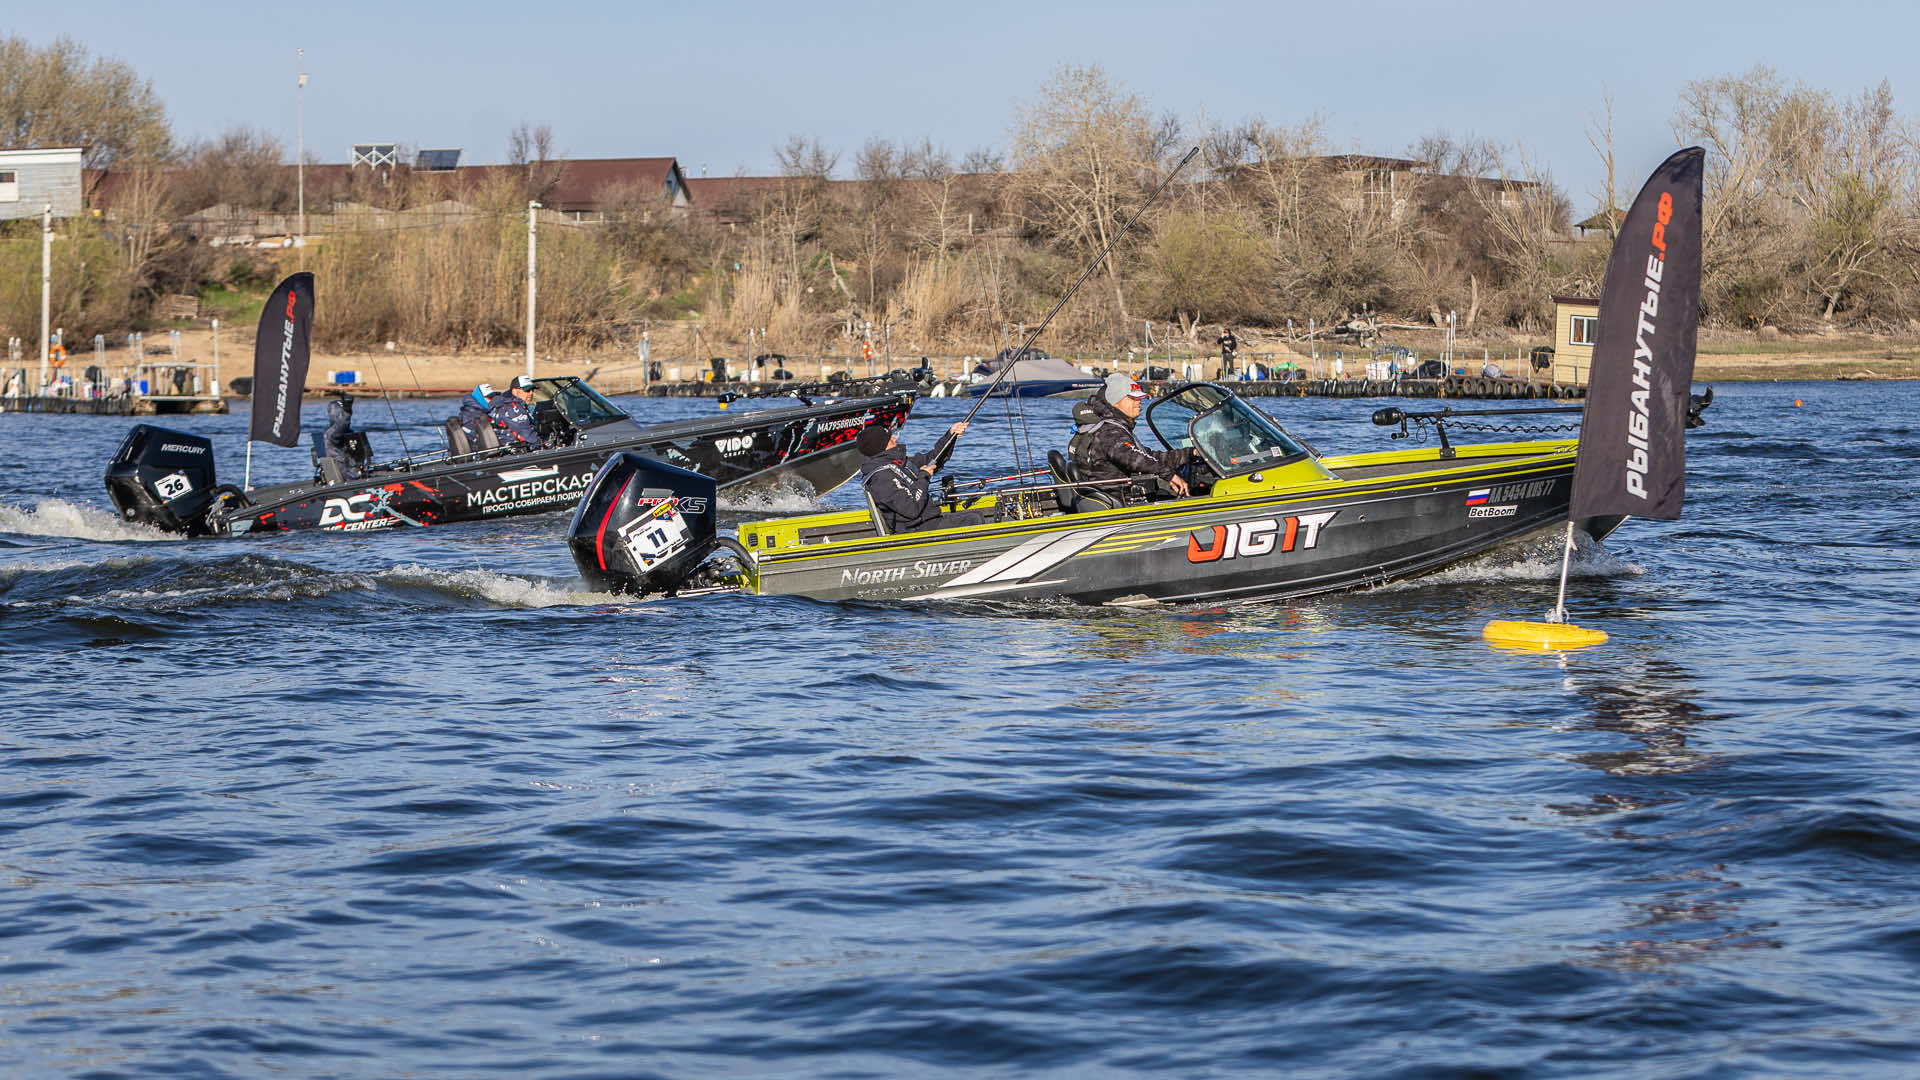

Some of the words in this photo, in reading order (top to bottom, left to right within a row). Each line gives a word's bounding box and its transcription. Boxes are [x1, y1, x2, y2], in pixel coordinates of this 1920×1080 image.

[1626, 191, 1672, 499] РЫБАНУТЫЕ.РФ
[272, 290, 296, 438] РЫБАНУТЫЕ.РФ
[161, 443, 206, 455] MERCURY
[164, 478, 184, 496] 26
[466, 472, 594, 507] МАСТЕРСКАЯ
[482, 502, 514, 514] ПРОСТО
[515, 495, 557, 508] СОБИРАЕМ
[556, 490, 585, 502] ЛОДКИ
[1469, 507, 1516, 517] BetBoom
[646, 528, 668, 548] 11
[1187, 511, 1338, 563] JIGIT
[840, 567, 906, 588] NORTH
[911, 560, 972, 579] SILVER
